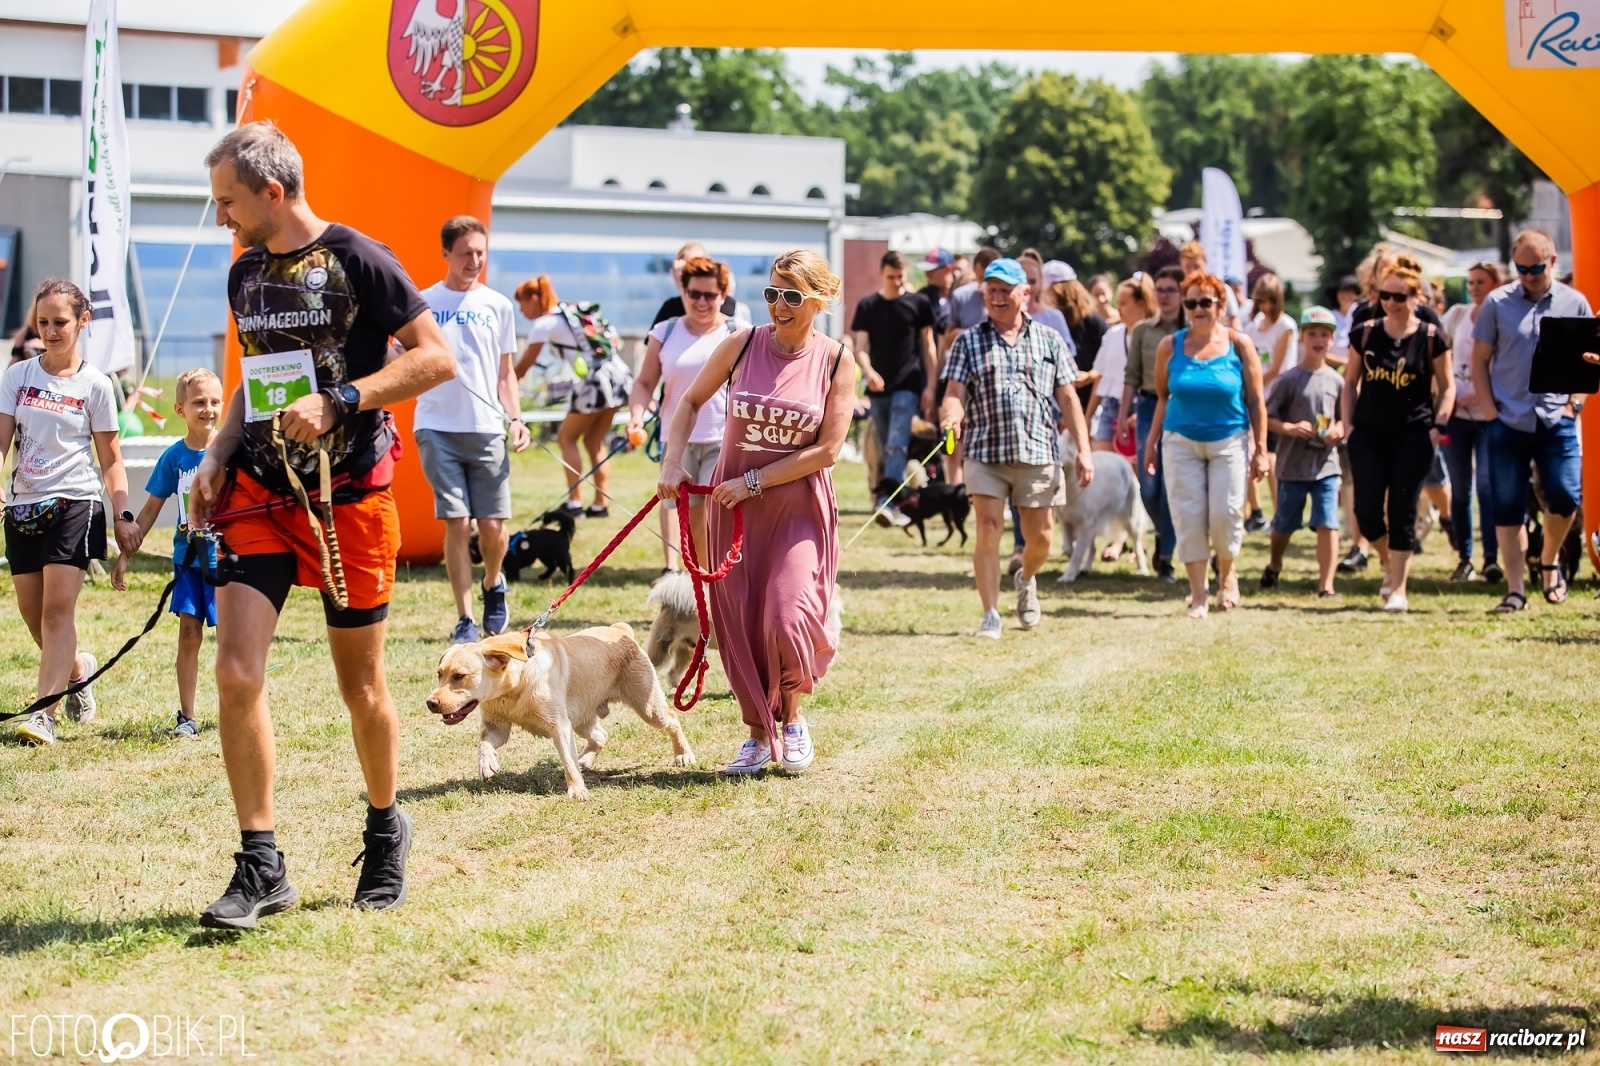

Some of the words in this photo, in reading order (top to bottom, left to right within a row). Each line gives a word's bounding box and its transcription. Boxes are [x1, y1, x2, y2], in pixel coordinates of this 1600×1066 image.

[108, 194, 122, 213] all
[250, 363, 302, 376] DOGTREKKING
[37, 390, 63, 402] BIEG
[265, 387, 287, 406] 18
[24, 397, 64, 413] GRANIC
[732, 399, 819, 433] HIPPIE
